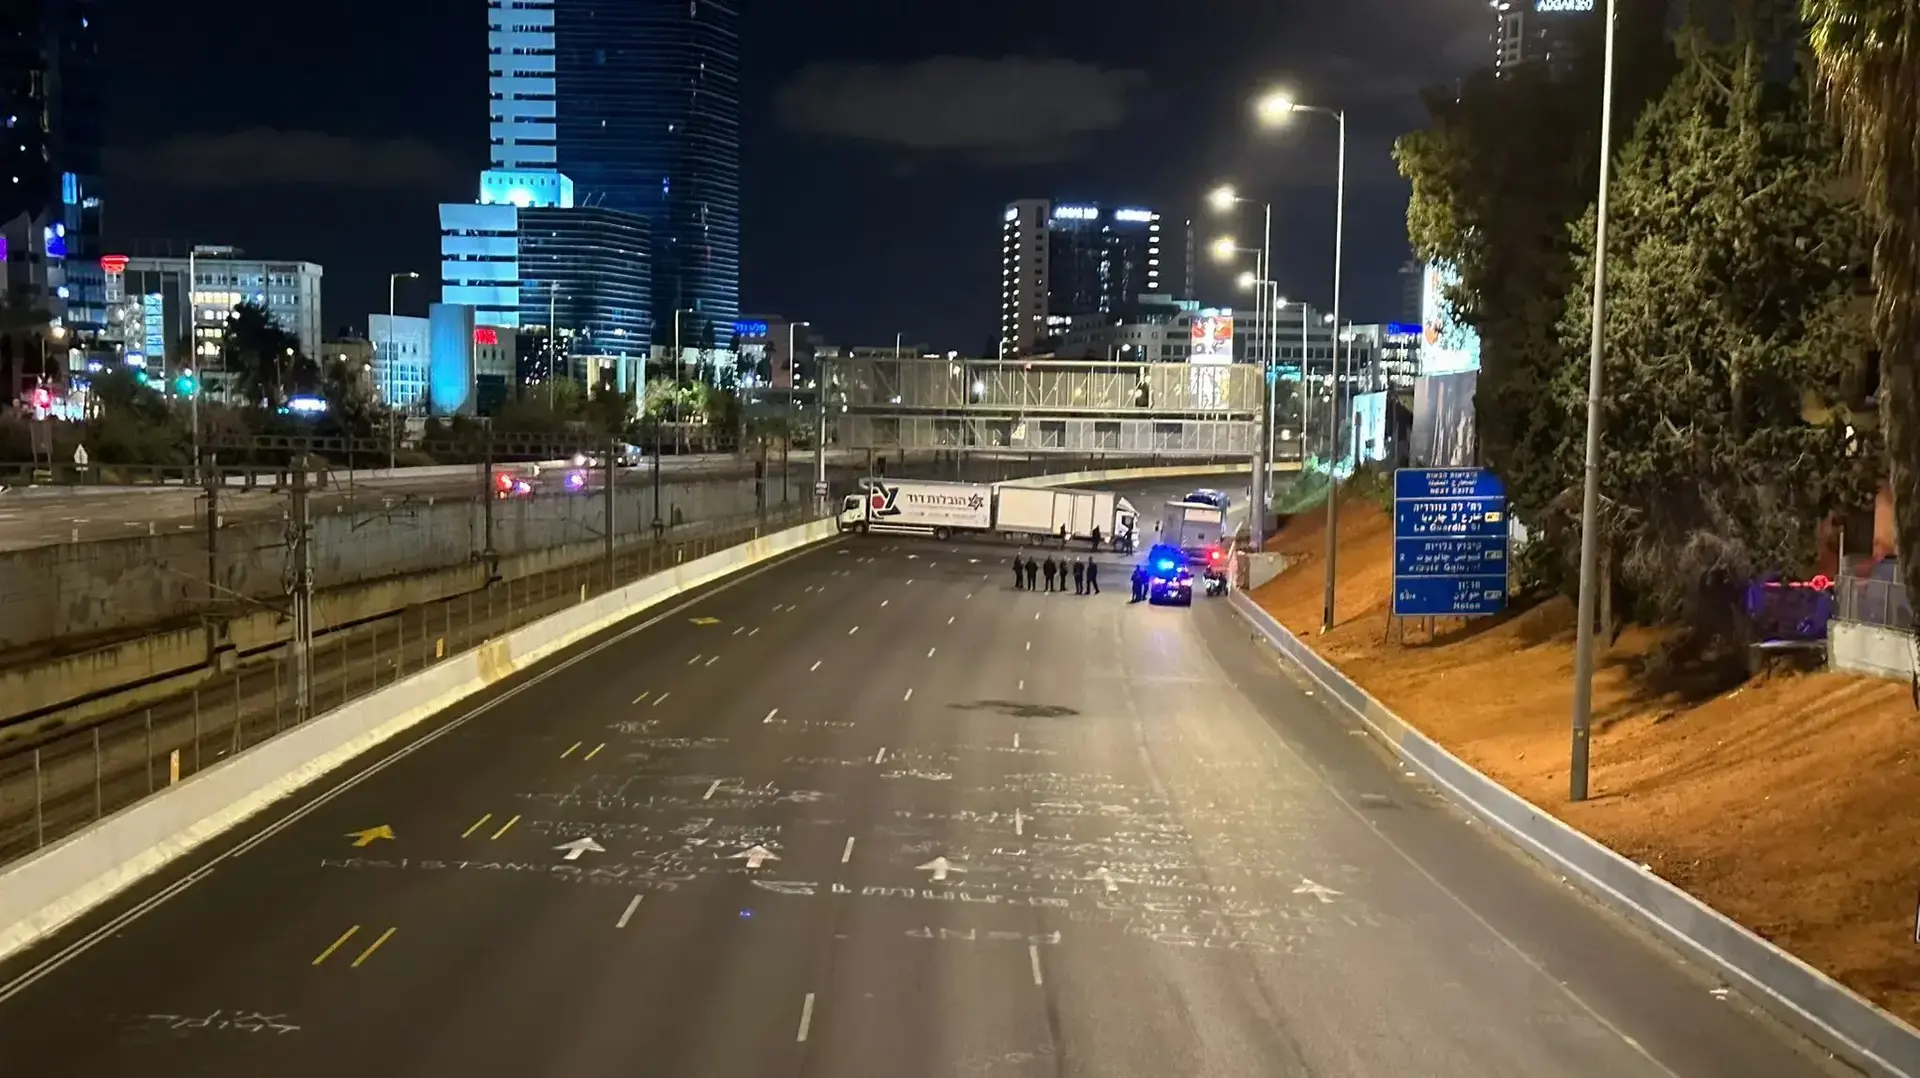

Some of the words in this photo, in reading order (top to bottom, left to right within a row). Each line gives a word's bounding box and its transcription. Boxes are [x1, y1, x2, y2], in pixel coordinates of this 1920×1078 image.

[906, 494, 924, 503] דוד
[927, 495, 966, 505] הובלות
[1429, 523, 1467, 532] Guardia
